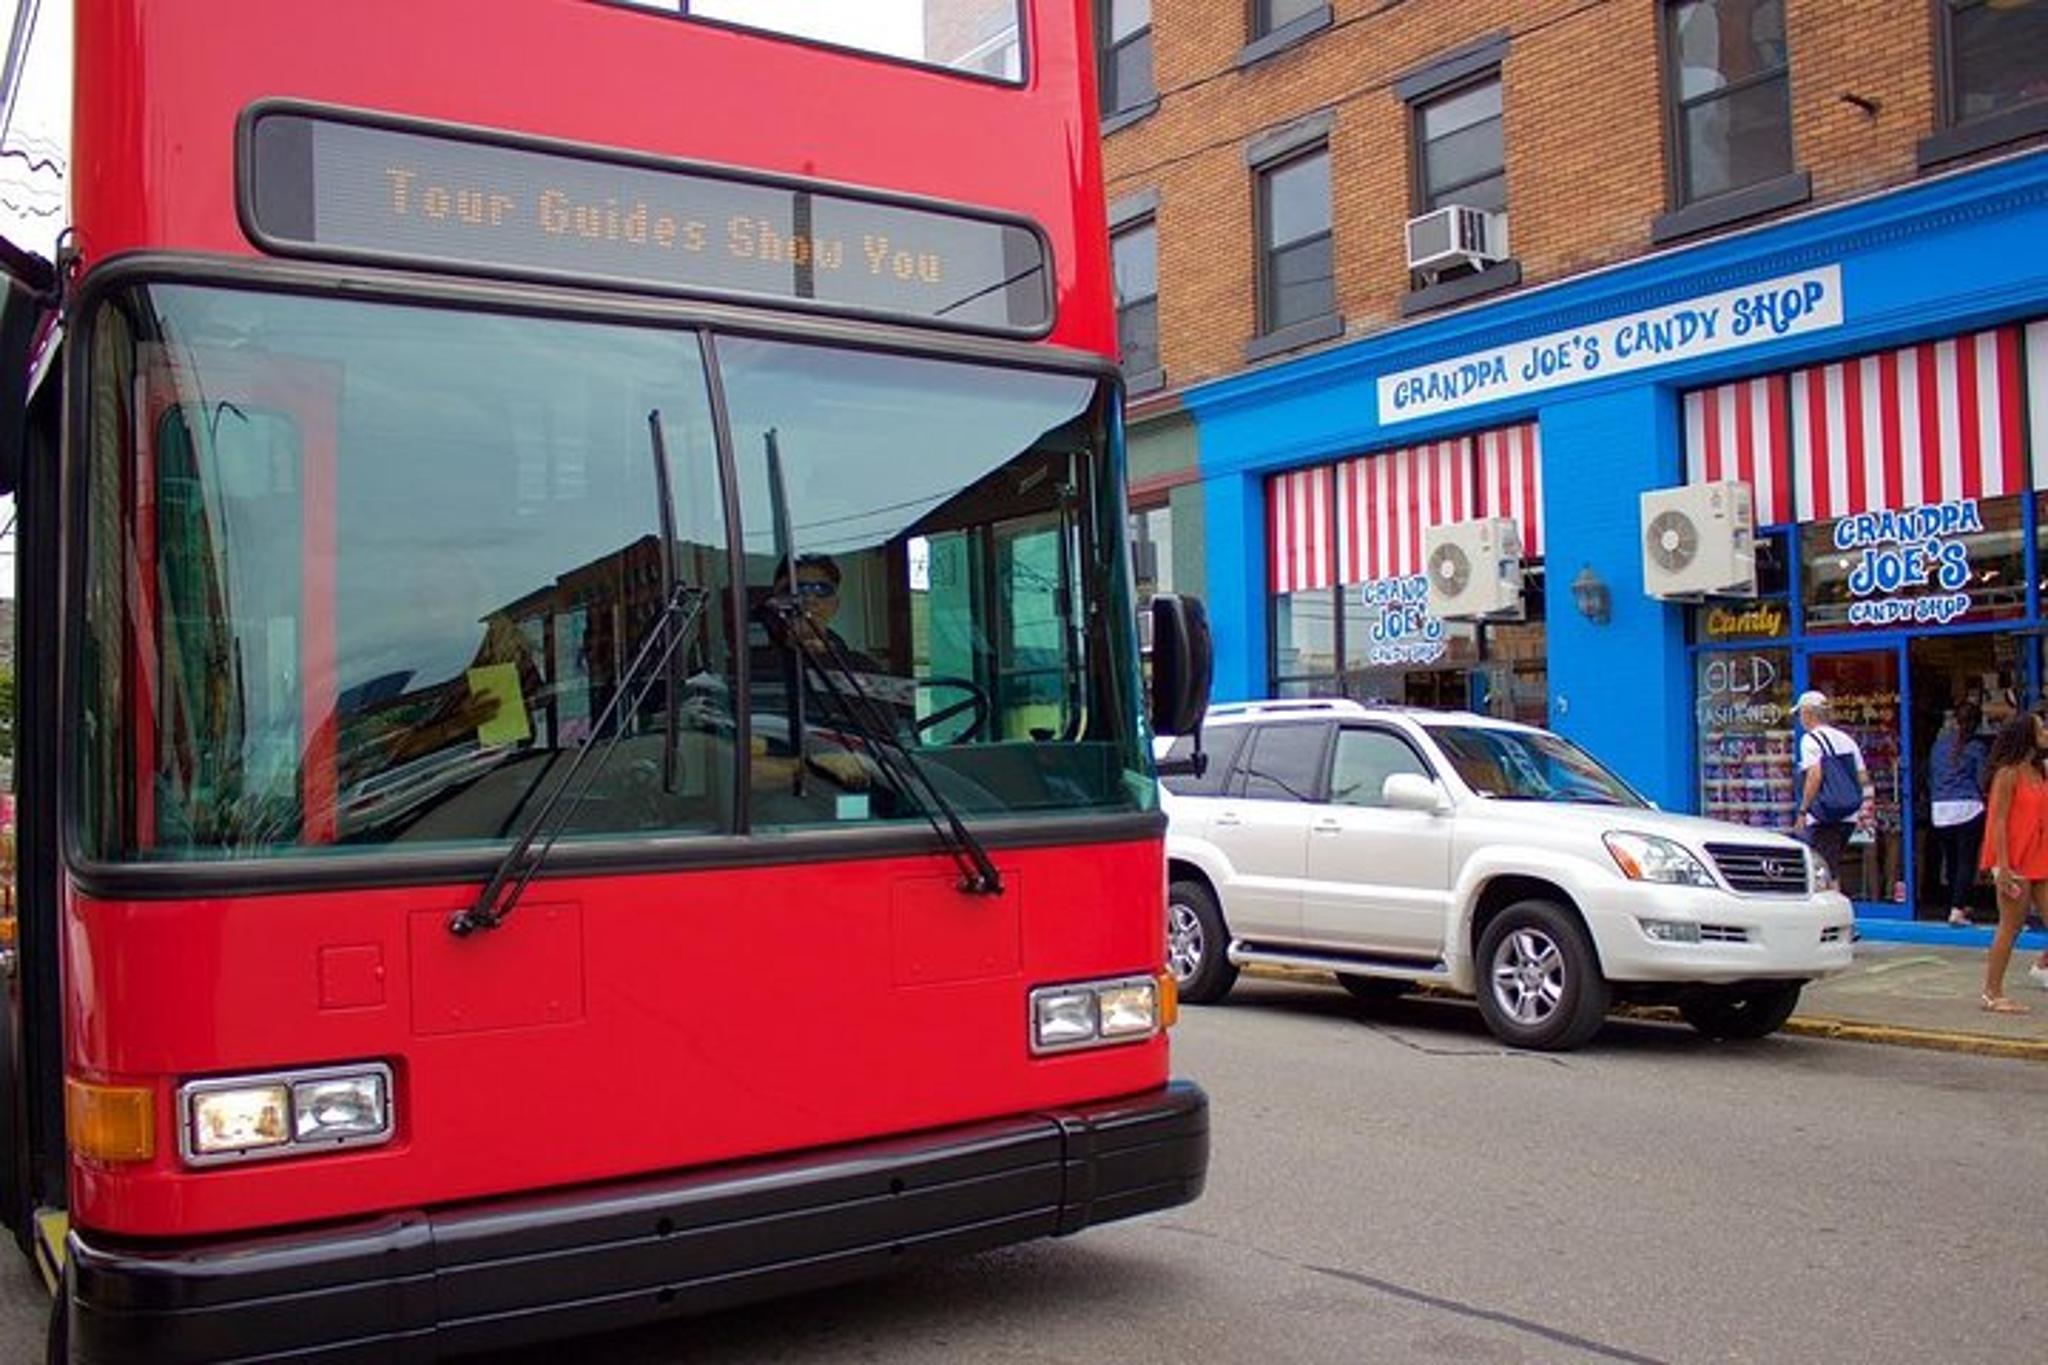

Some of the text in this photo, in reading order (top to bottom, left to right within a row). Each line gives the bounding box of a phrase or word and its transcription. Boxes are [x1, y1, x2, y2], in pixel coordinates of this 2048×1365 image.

[386, 167, 945, 283] Tour Guides Show You
[1392, 280, 1825, 410] GRANDPA JOE'S CANDY SHOP
[1835, 499, 1982, 549] GRANDPA
[1850, 540, 1971, 595] JOE'S
[1363, 576, 1430, 605] GRAND
[1849, 594, 1970, 623] CANDY SHOP
[1707, 603, 1783, 635] Candy
[1704, 656, 1776, 695] OLD
